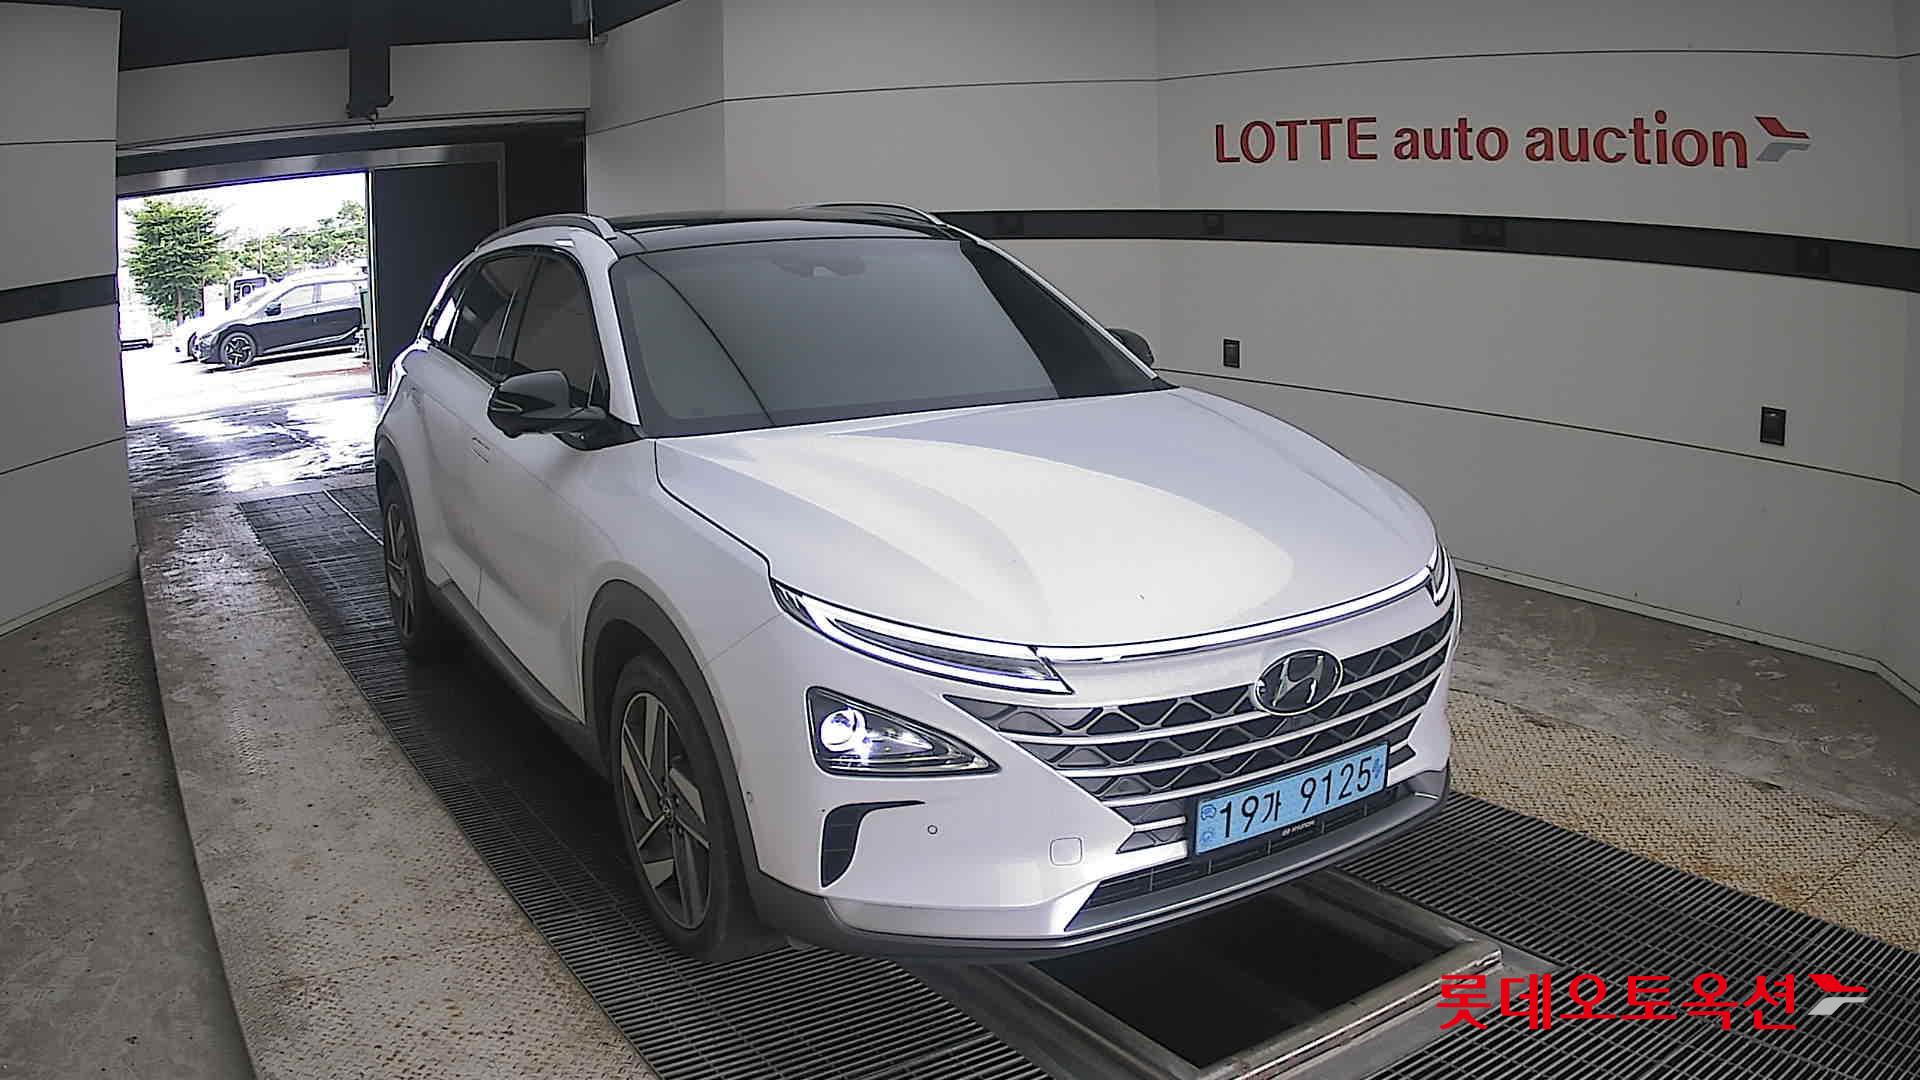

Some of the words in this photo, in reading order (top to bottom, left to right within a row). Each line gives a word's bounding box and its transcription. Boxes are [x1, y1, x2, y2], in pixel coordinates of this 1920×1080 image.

[1215, 116, 1378, 163] LOTTE
[1393, 117, 1509, 160] auto
[1525, 110, 1748, 168] auction
[1219, 790, 1282, 838] 19가
[1300, 756, 1372, 814] 9125
